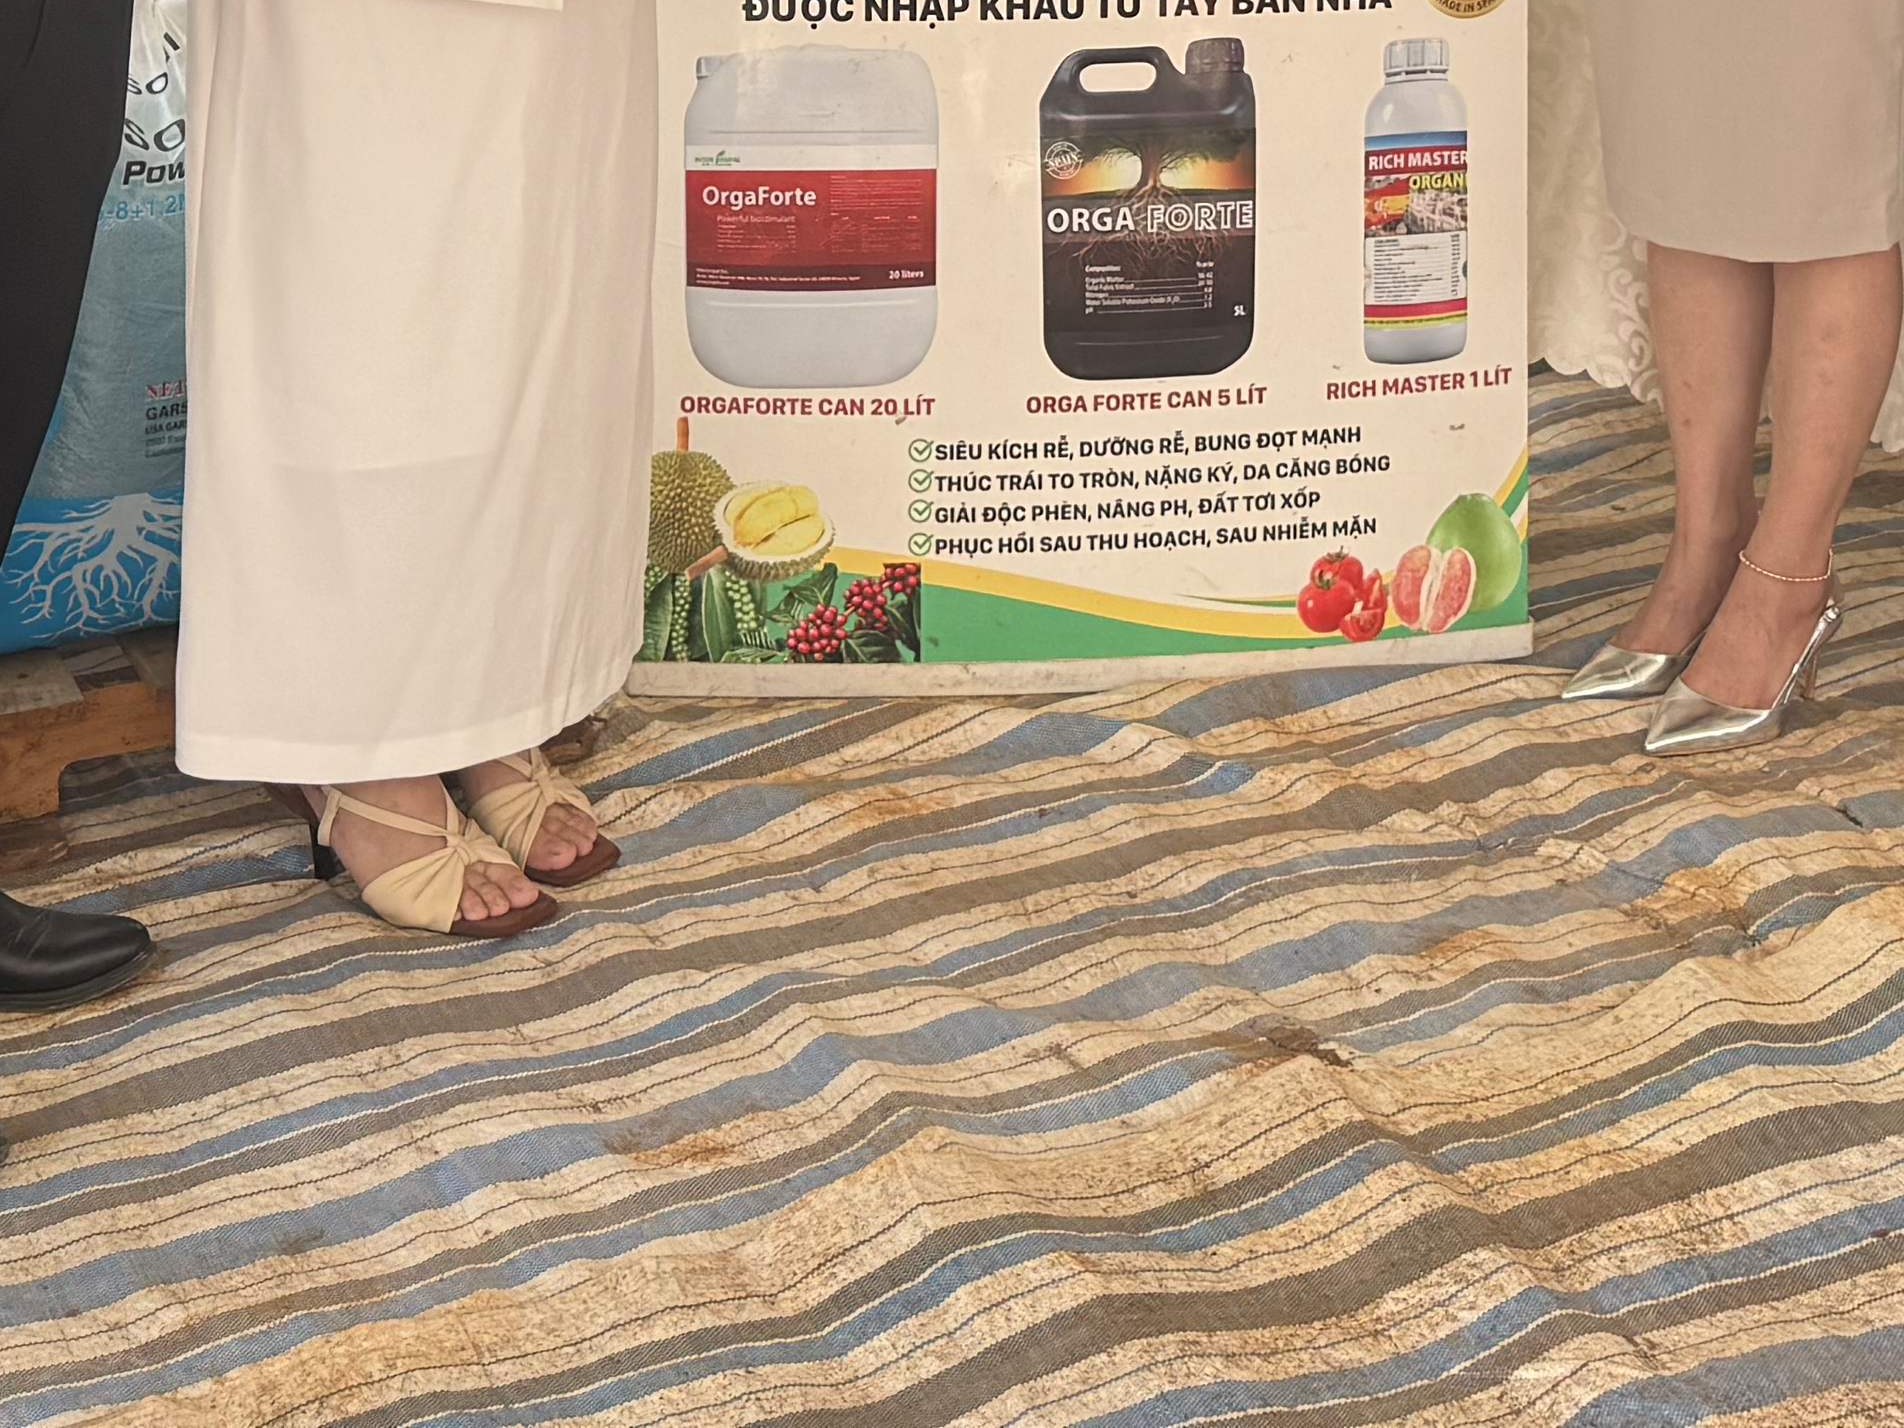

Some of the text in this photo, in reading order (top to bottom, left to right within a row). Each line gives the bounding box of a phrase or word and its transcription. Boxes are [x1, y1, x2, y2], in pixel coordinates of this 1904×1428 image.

[702, 186, 817, 211] OrgaForte
[1047, 200, 1253, 233] ORGA FORTE
[1025, 384, 1267, 414] ORGA FORTE CAN 5 LÍT
[1325, 366, 1512, 400] RICH MASTER 1 LÍT
[679, 393, 935, 418] ORGAFORTE CAN 20 LÍT
[934, 441, 984, 461] SIÊU
[987, 442, 1038, 460] KÍCH
[1079, 437, 1155, 457] DƯỠNG
[1194, 434, 1251, 452] BUNG
[1256, 430, 1298, 453] ĐỌT
[1302, 426, 1362, 448] MẠNH
[934, 538, 993, 559] PHỤC
[1040, 535, 1083, 553] SAU
[1086, 534, 1129, 551] THU
[1133, 529, 1211, 553] HOẠCH,
[1215, 527, 1259, 545] SAU
